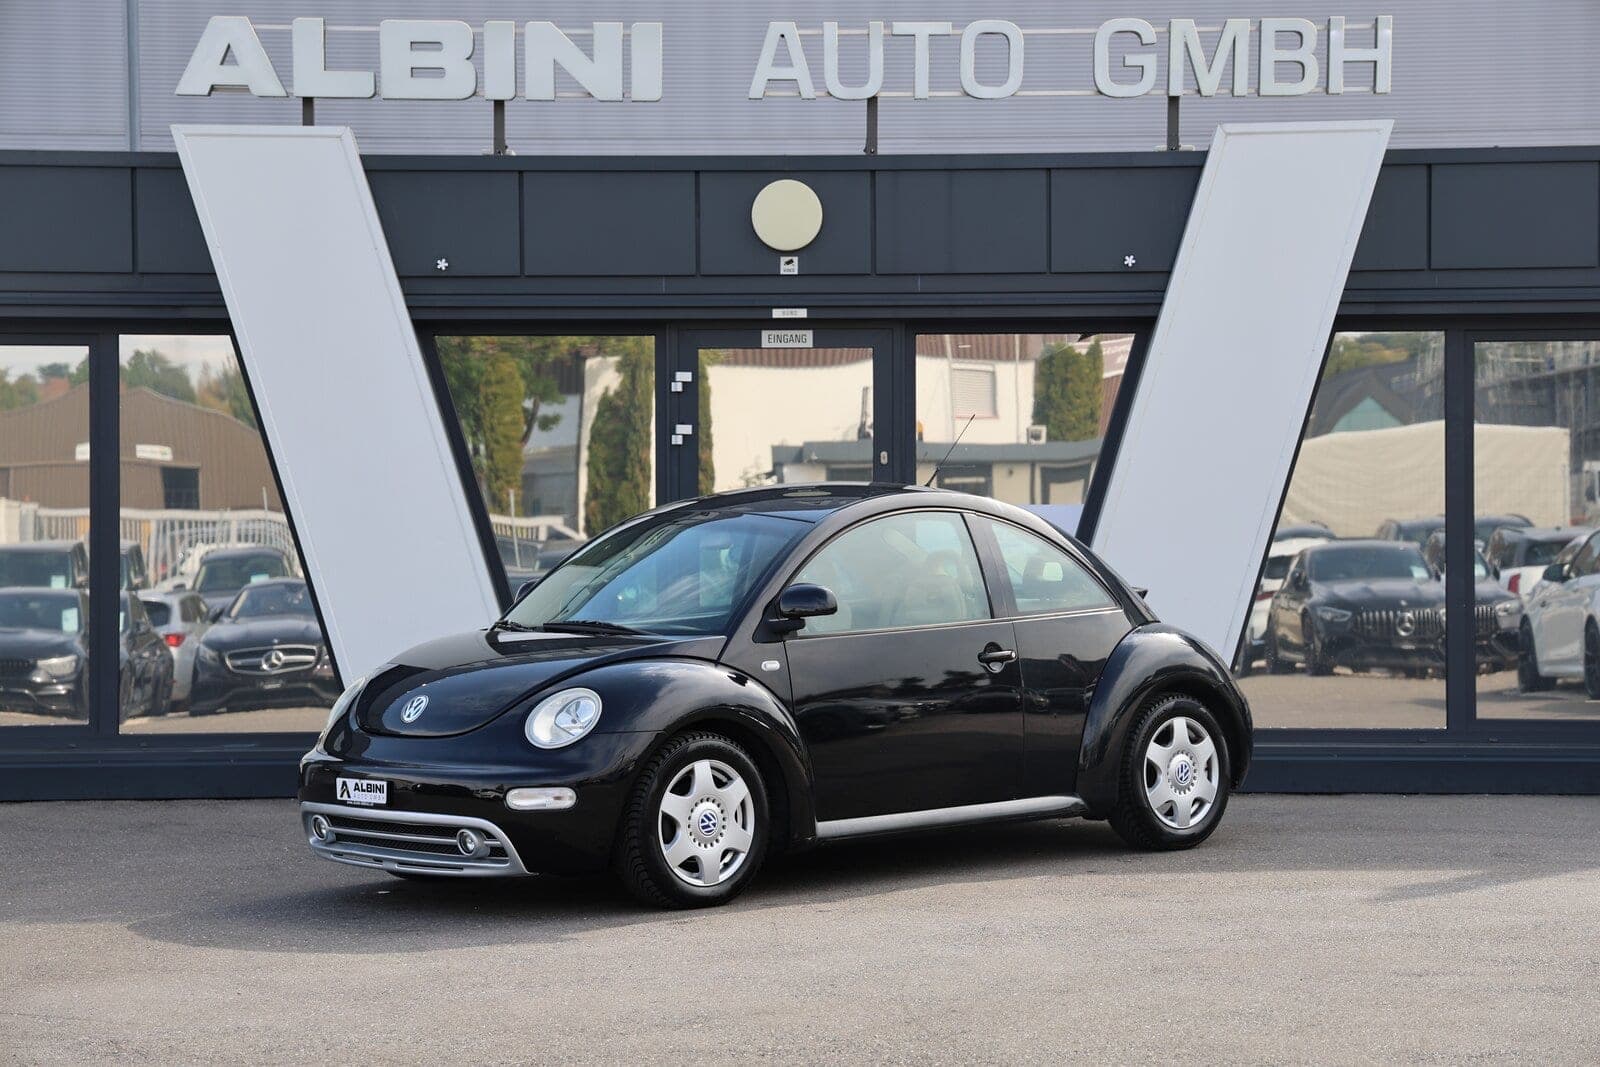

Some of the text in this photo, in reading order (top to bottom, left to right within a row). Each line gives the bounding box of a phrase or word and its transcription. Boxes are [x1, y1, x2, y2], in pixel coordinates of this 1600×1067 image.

[174, 15, 1394, 102] ALBINI AUTO GMBH
[767, 333, 807, 344] EINGANG
[353, 781, 385, 795] ALBINI
